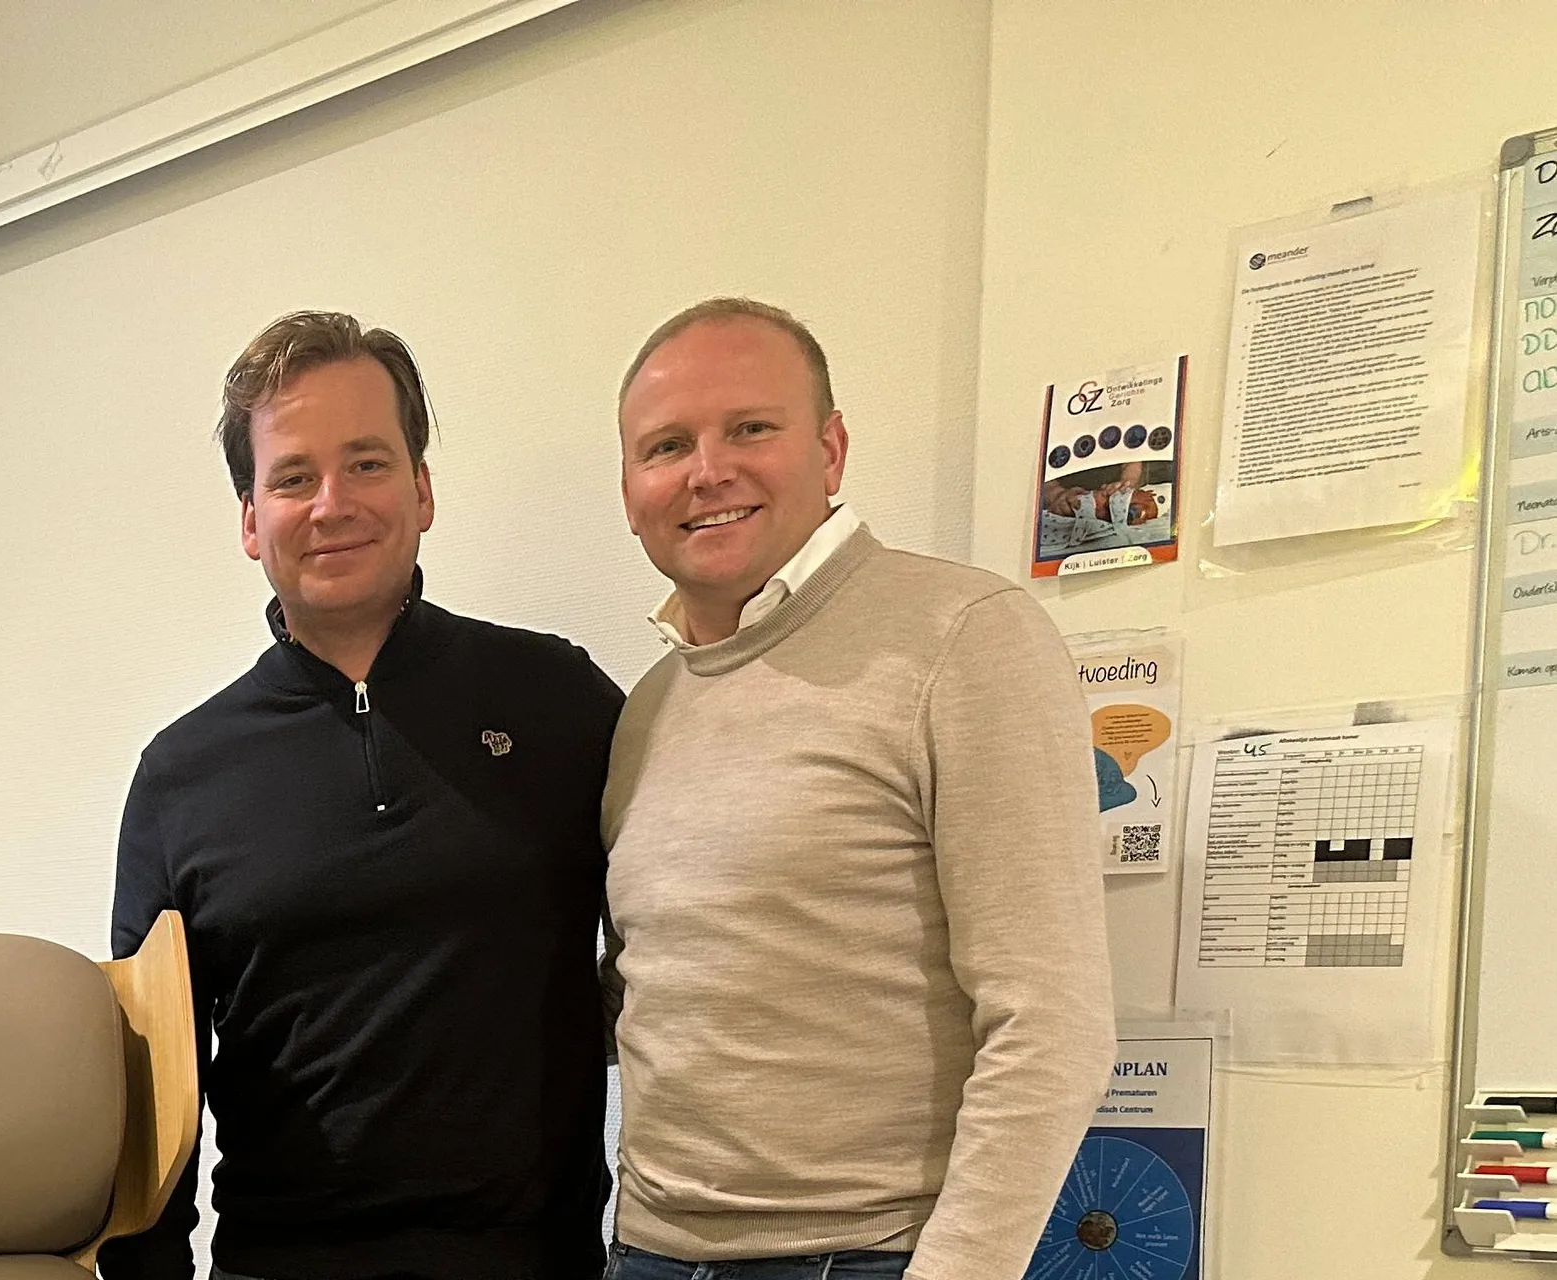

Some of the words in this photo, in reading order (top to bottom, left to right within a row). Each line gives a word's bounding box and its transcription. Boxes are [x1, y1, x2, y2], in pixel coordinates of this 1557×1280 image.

[1064, 562, 1081, 571] Kijk
[1088, 556, 1119, 567] Luister
[1110, 1088, 1158, 1097] Prematuren
[1119, 1105, 1154, 1114] Centrum
